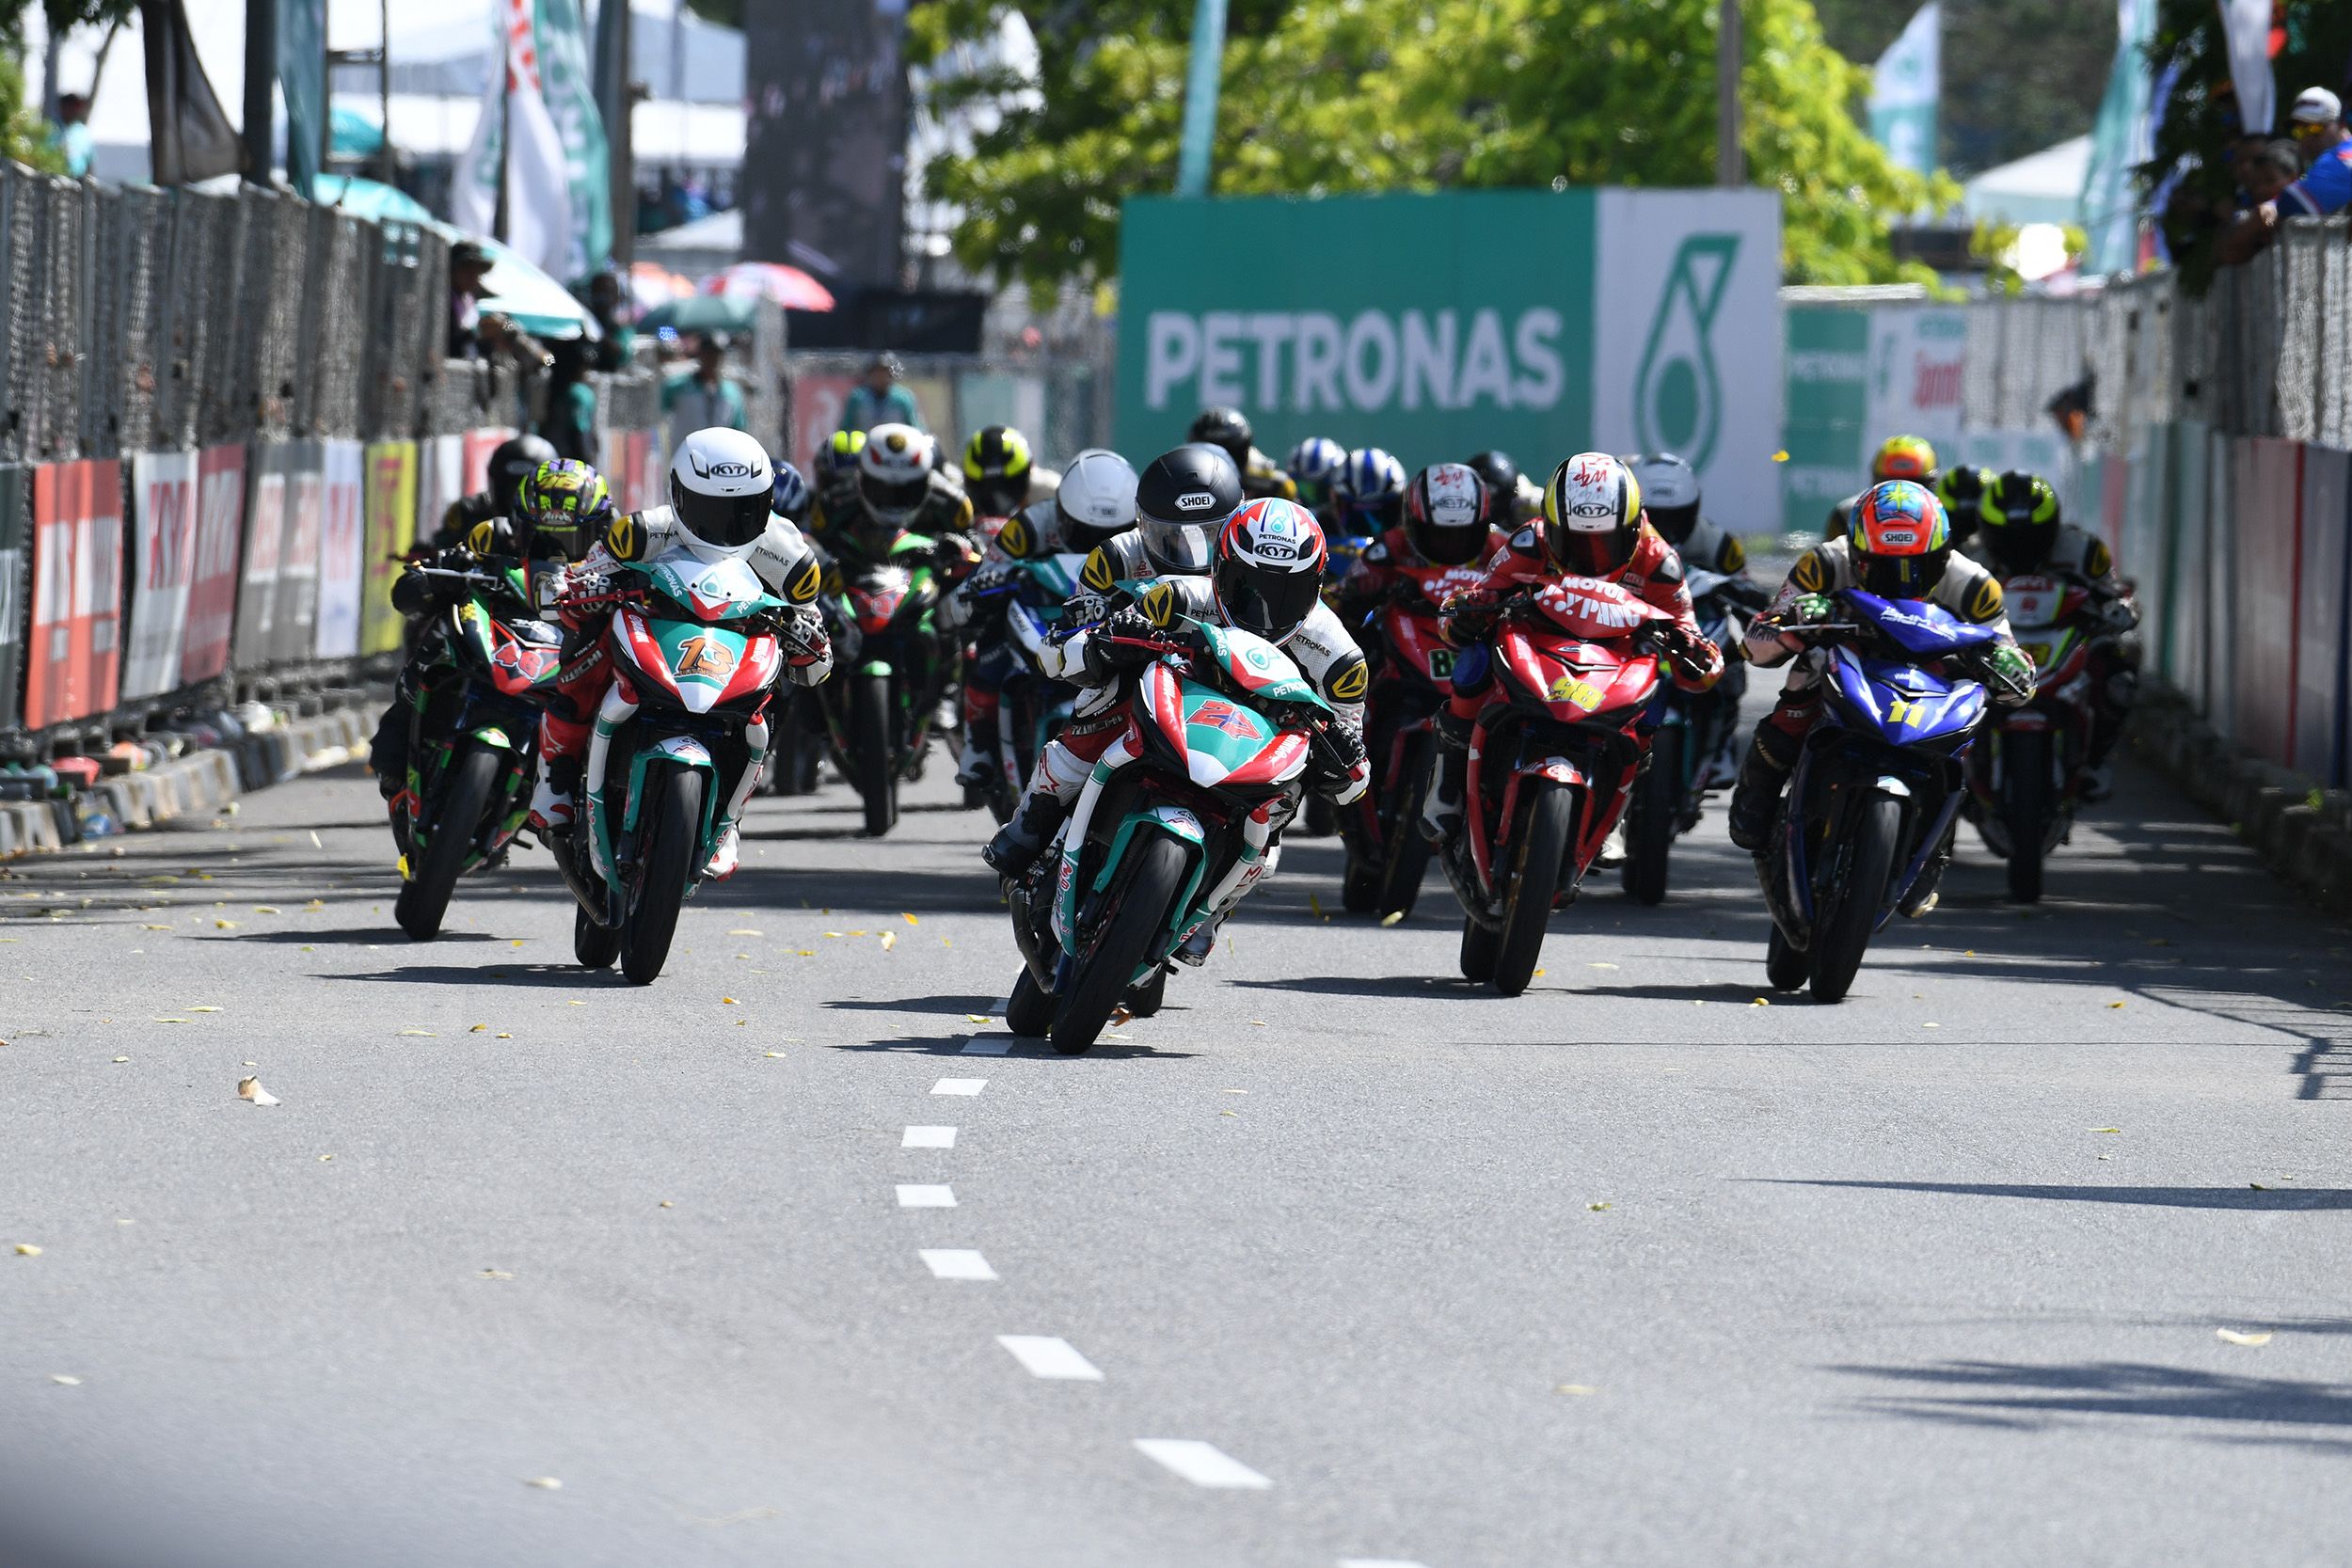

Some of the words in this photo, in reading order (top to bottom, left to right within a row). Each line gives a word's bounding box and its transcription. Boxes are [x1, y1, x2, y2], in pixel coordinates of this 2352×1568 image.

[1145, 309, 1565, 412] PETRONAS
[715, 465, 746, 475] KYT
[1181, 497, 1210, 507] SHOEI
[1579, 503, 1609, 517] KYT
[1258, 532, 1296, 545] PETRONAS
[1884, 532, 1913, 543] SHOEI
[1258, 545, 1292, 558] KYT
[1560, 576, 1627, 602] MOTUL
[678, 635, 735, 677] 13
[1185, 700, 1263, 741] 24
[1887, 700, 1927, 729] 11
